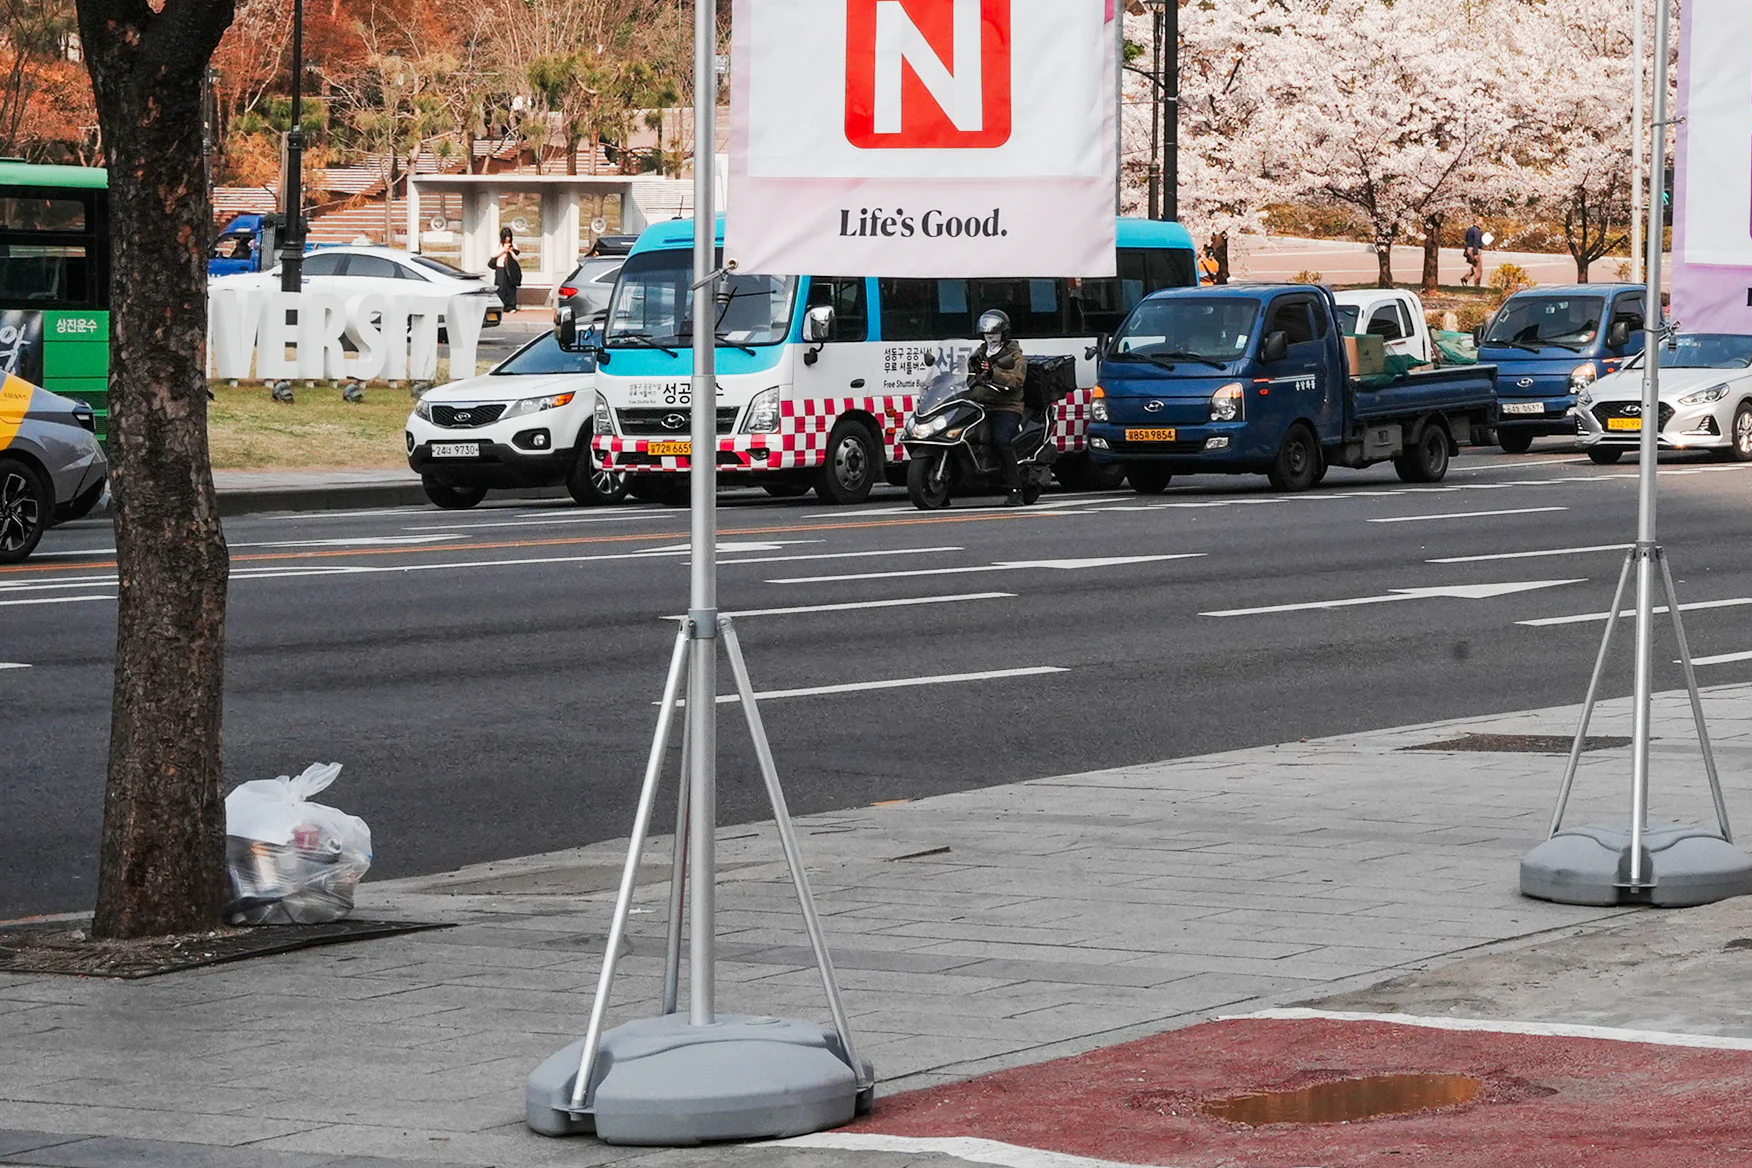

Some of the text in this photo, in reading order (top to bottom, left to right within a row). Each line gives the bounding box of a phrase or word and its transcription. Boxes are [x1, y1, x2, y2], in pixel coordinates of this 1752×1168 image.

[839, 207, 1007, 238] Life's Good.
[56, 318, 98, 334] 상진운수
[207, 290, 487, 381] VERSITY
[884, 347, 904, 362] 성동구
[884, 362, 926, 375] 무료 셔틀버스
[883, 379, 896, 388] Free
[896, 379, 916, 388] Shuttle
[1151, 430, 1173, 440] 9854
[454, 445, 475, 455] 9730
